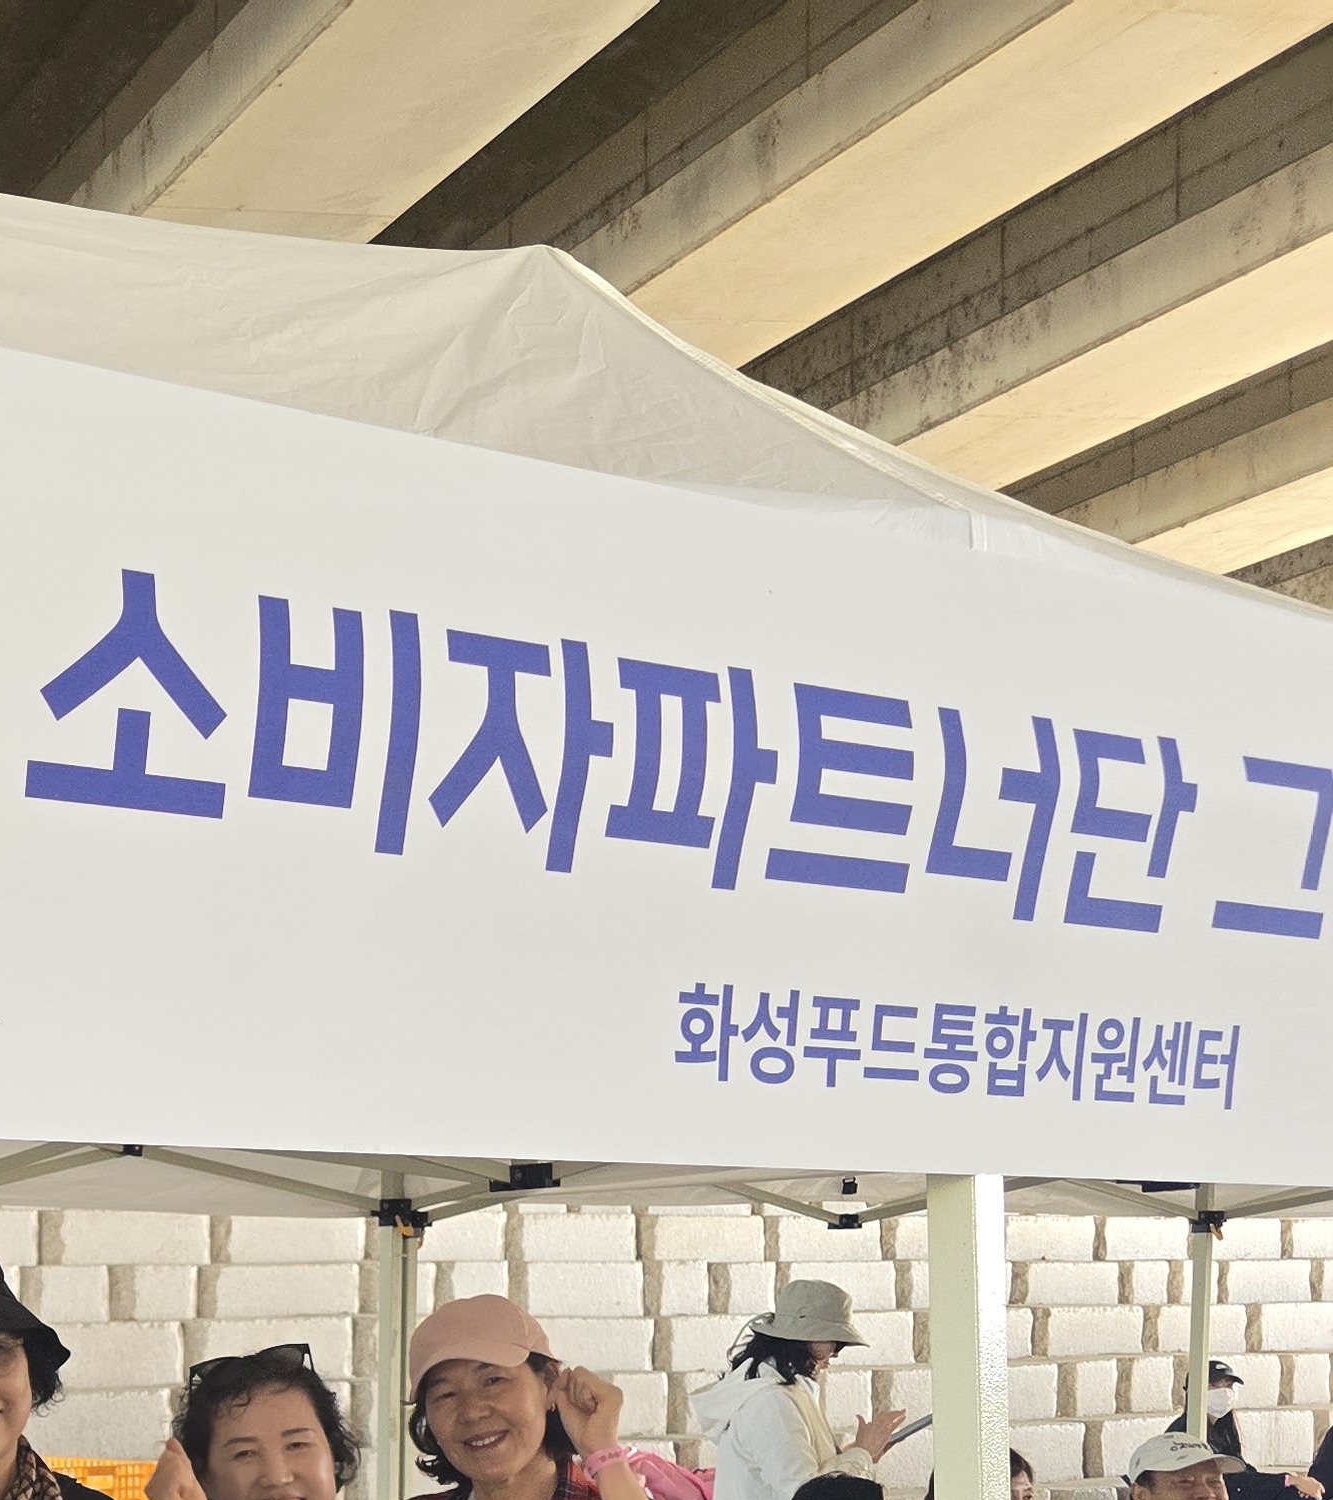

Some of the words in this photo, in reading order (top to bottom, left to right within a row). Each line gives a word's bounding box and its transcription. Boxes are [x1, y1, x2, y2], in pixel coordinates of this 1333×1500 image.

[24, 568, 1198, 933] 소비자파트너단
[1212, 754, 1332, 939] 그
[675, 981, 1242, 1110] 화성푸드통합지원센터
